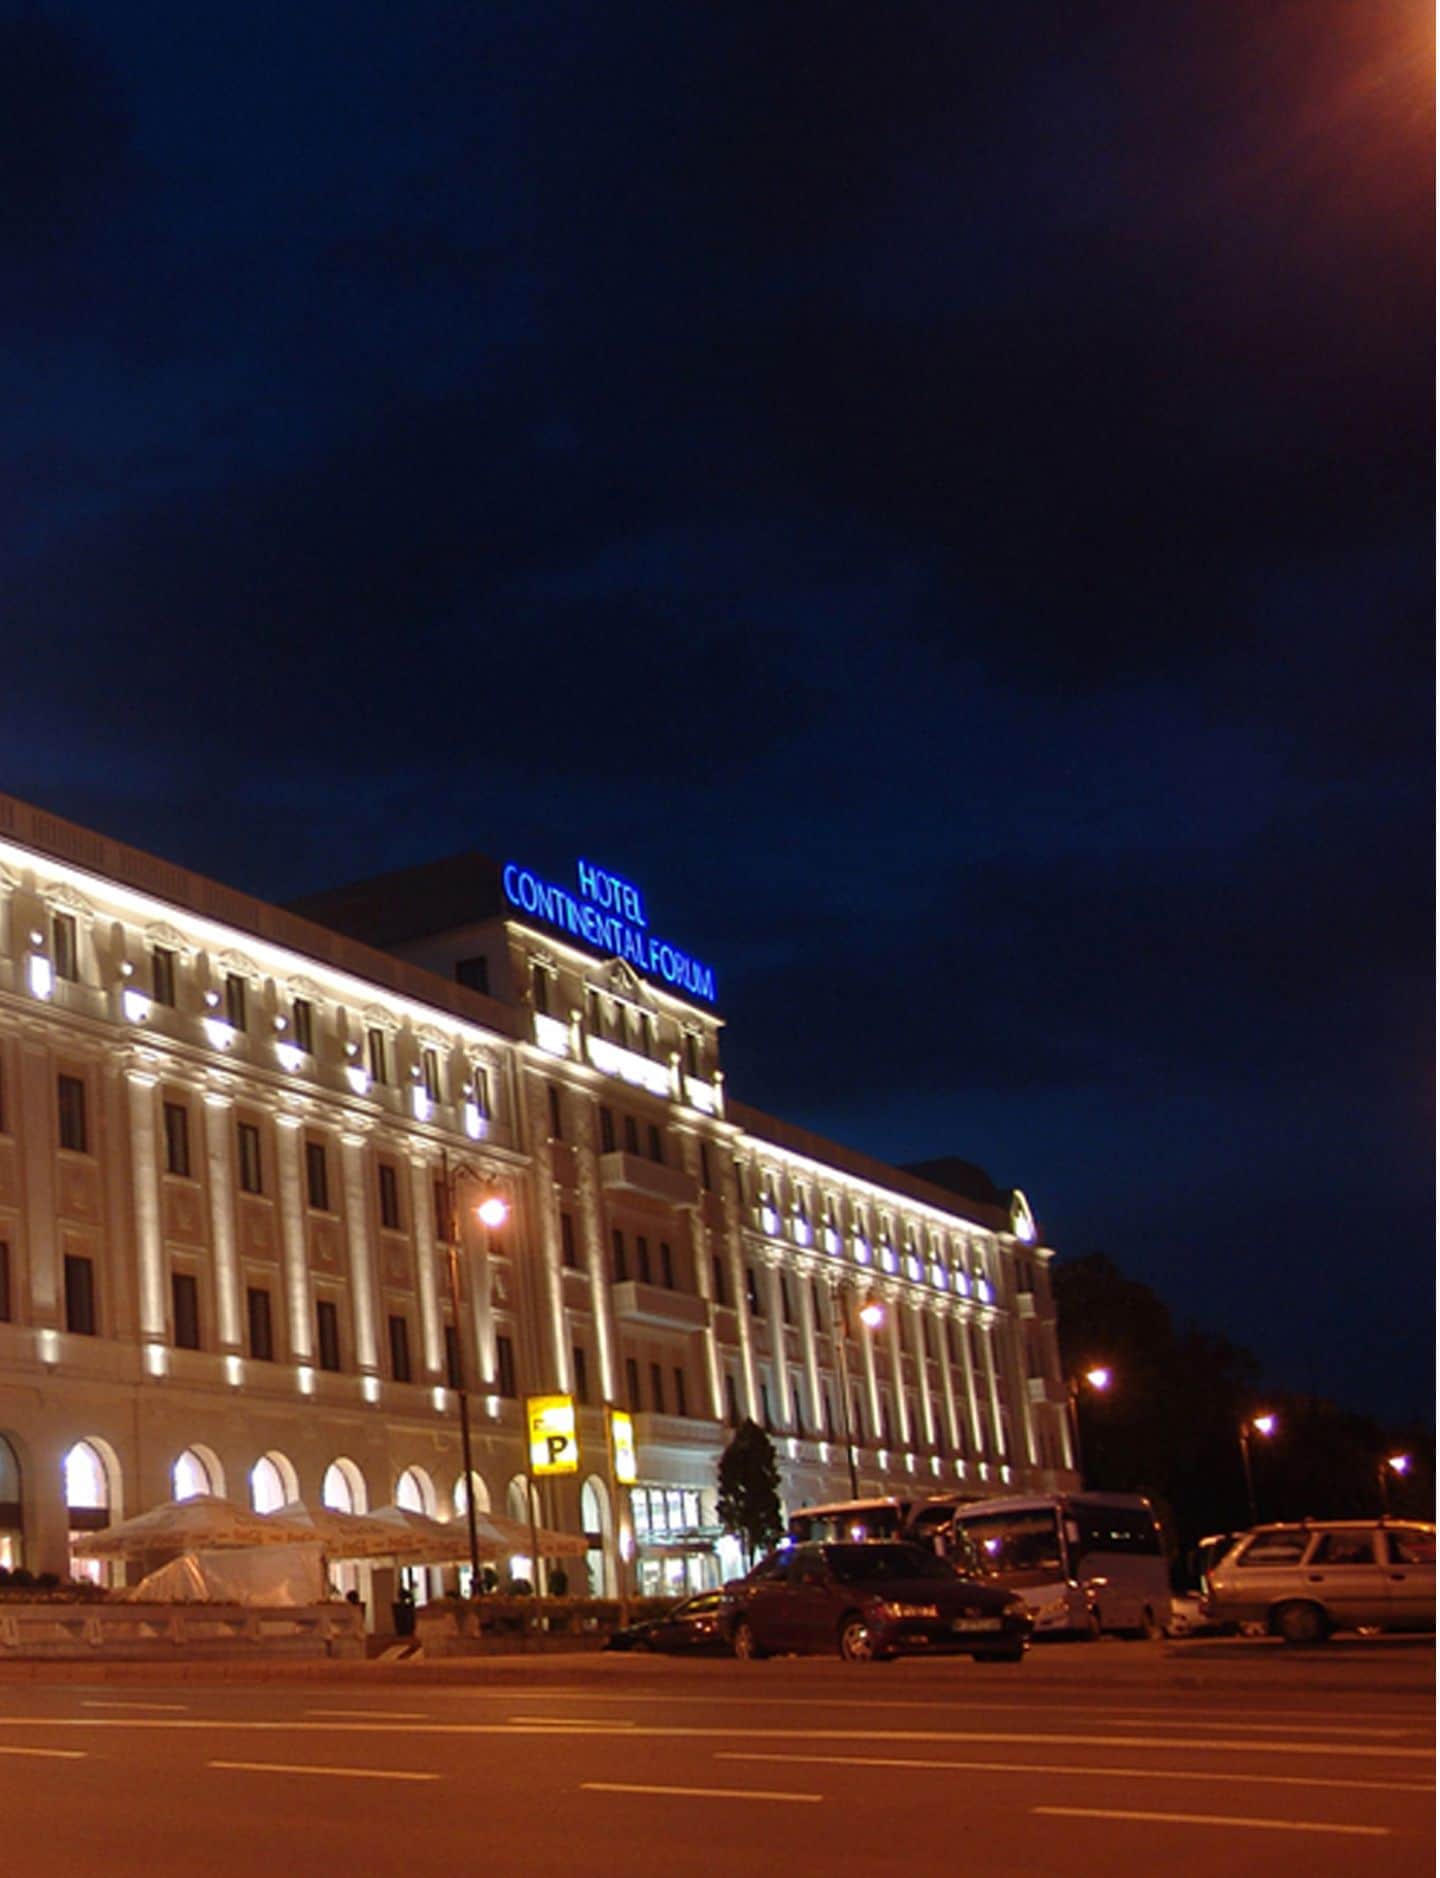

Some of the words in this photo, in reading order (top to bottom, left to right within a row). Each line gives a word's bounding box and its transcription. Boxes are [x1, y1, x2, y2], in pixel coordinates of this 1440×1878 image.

[576, 858, 646, 927] HOTEL
[502, 864, 649, 970] CONTINENTAL
[648, 938, 716, 1002] FORUM
[545, 1435, 569, 1465] P
